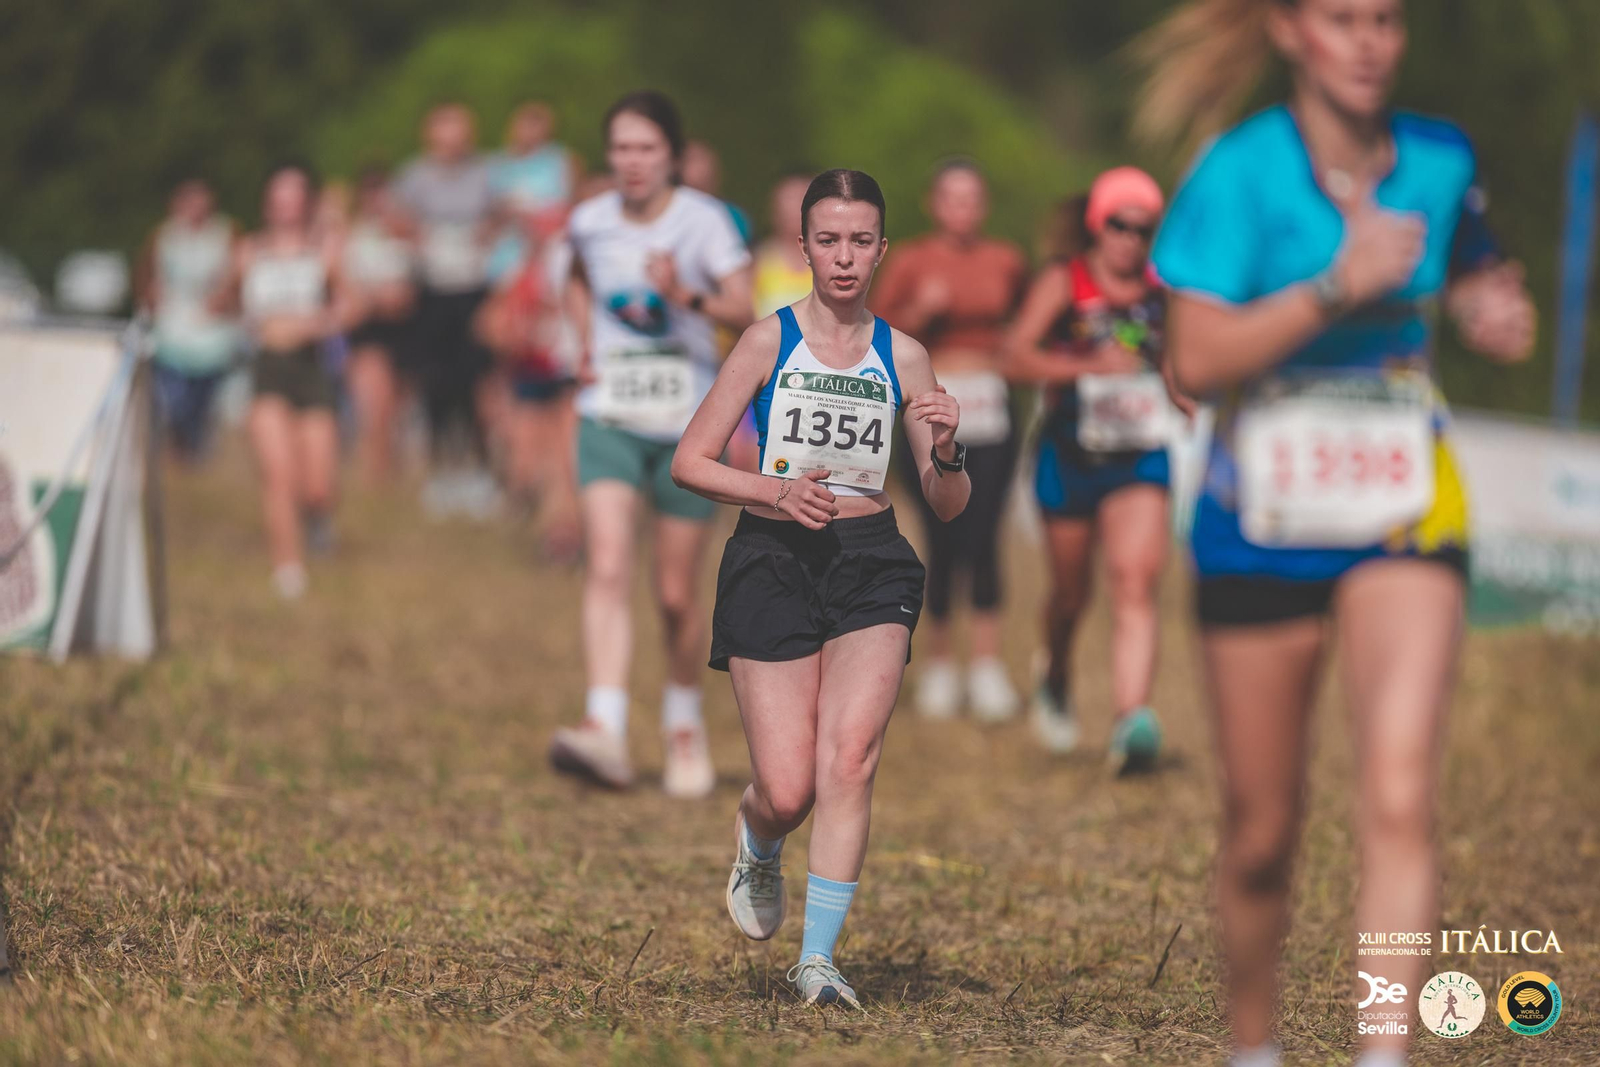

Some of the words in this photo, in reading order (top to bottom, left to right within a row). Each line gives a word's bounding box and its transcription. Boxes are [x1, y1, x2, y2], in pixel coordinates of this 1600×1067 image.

[812, 376, 866, 394] ITÁLICA
[817, 402, 856, 411] INDEPENDIENTE
[783, 408, 884, 454] 1354
